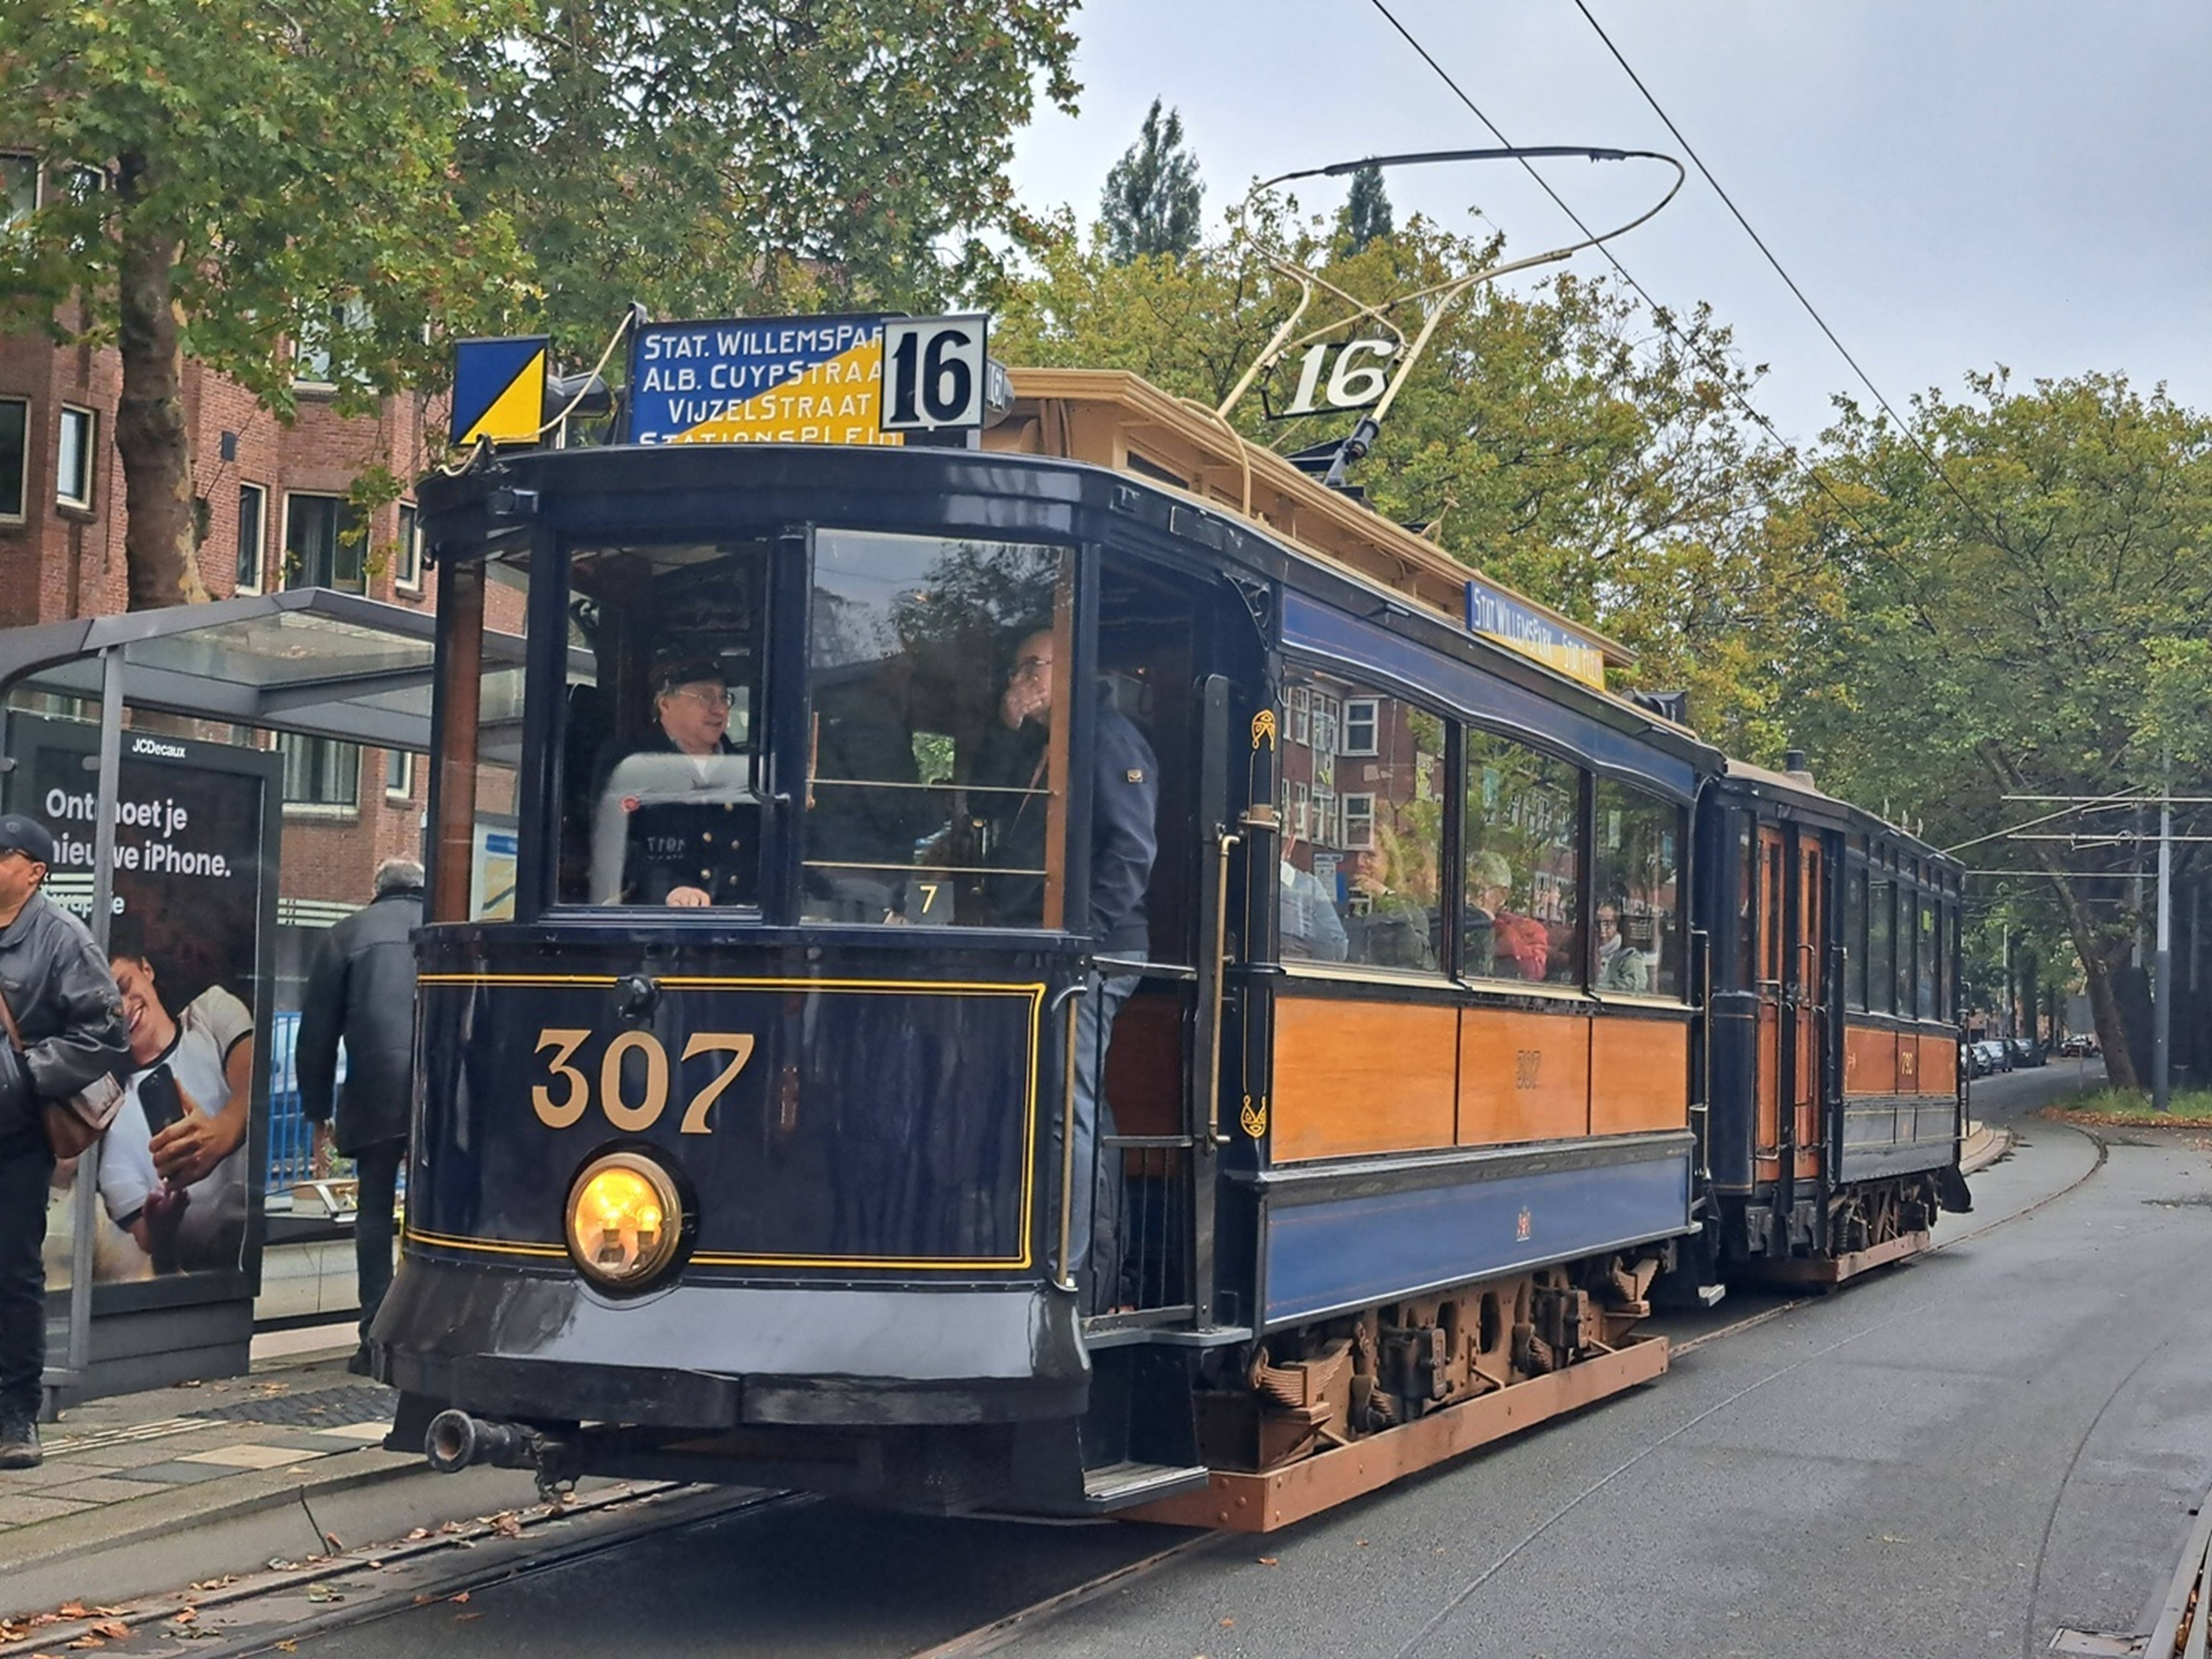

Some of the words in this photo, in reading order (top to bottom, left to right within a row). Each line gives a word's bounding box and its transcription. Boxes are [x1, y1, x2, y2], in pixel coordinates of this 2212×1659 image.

[644, 335, 709, 360] STAT.
[643, 366, 702, 392] ALB.
[890, 330, 971, 423] 16
[1283, 339, 1393, 415] 16
[668, 393, 871, 423] VIJZELSTRAAT
[132, 738, 185, 758] JCDecaux
[164, 799, 188, 838] je
[144, 840, 232, 877] iPhone.
[919, 885, 937, 914] 7
[532, 1028, 754, 1134] 307
